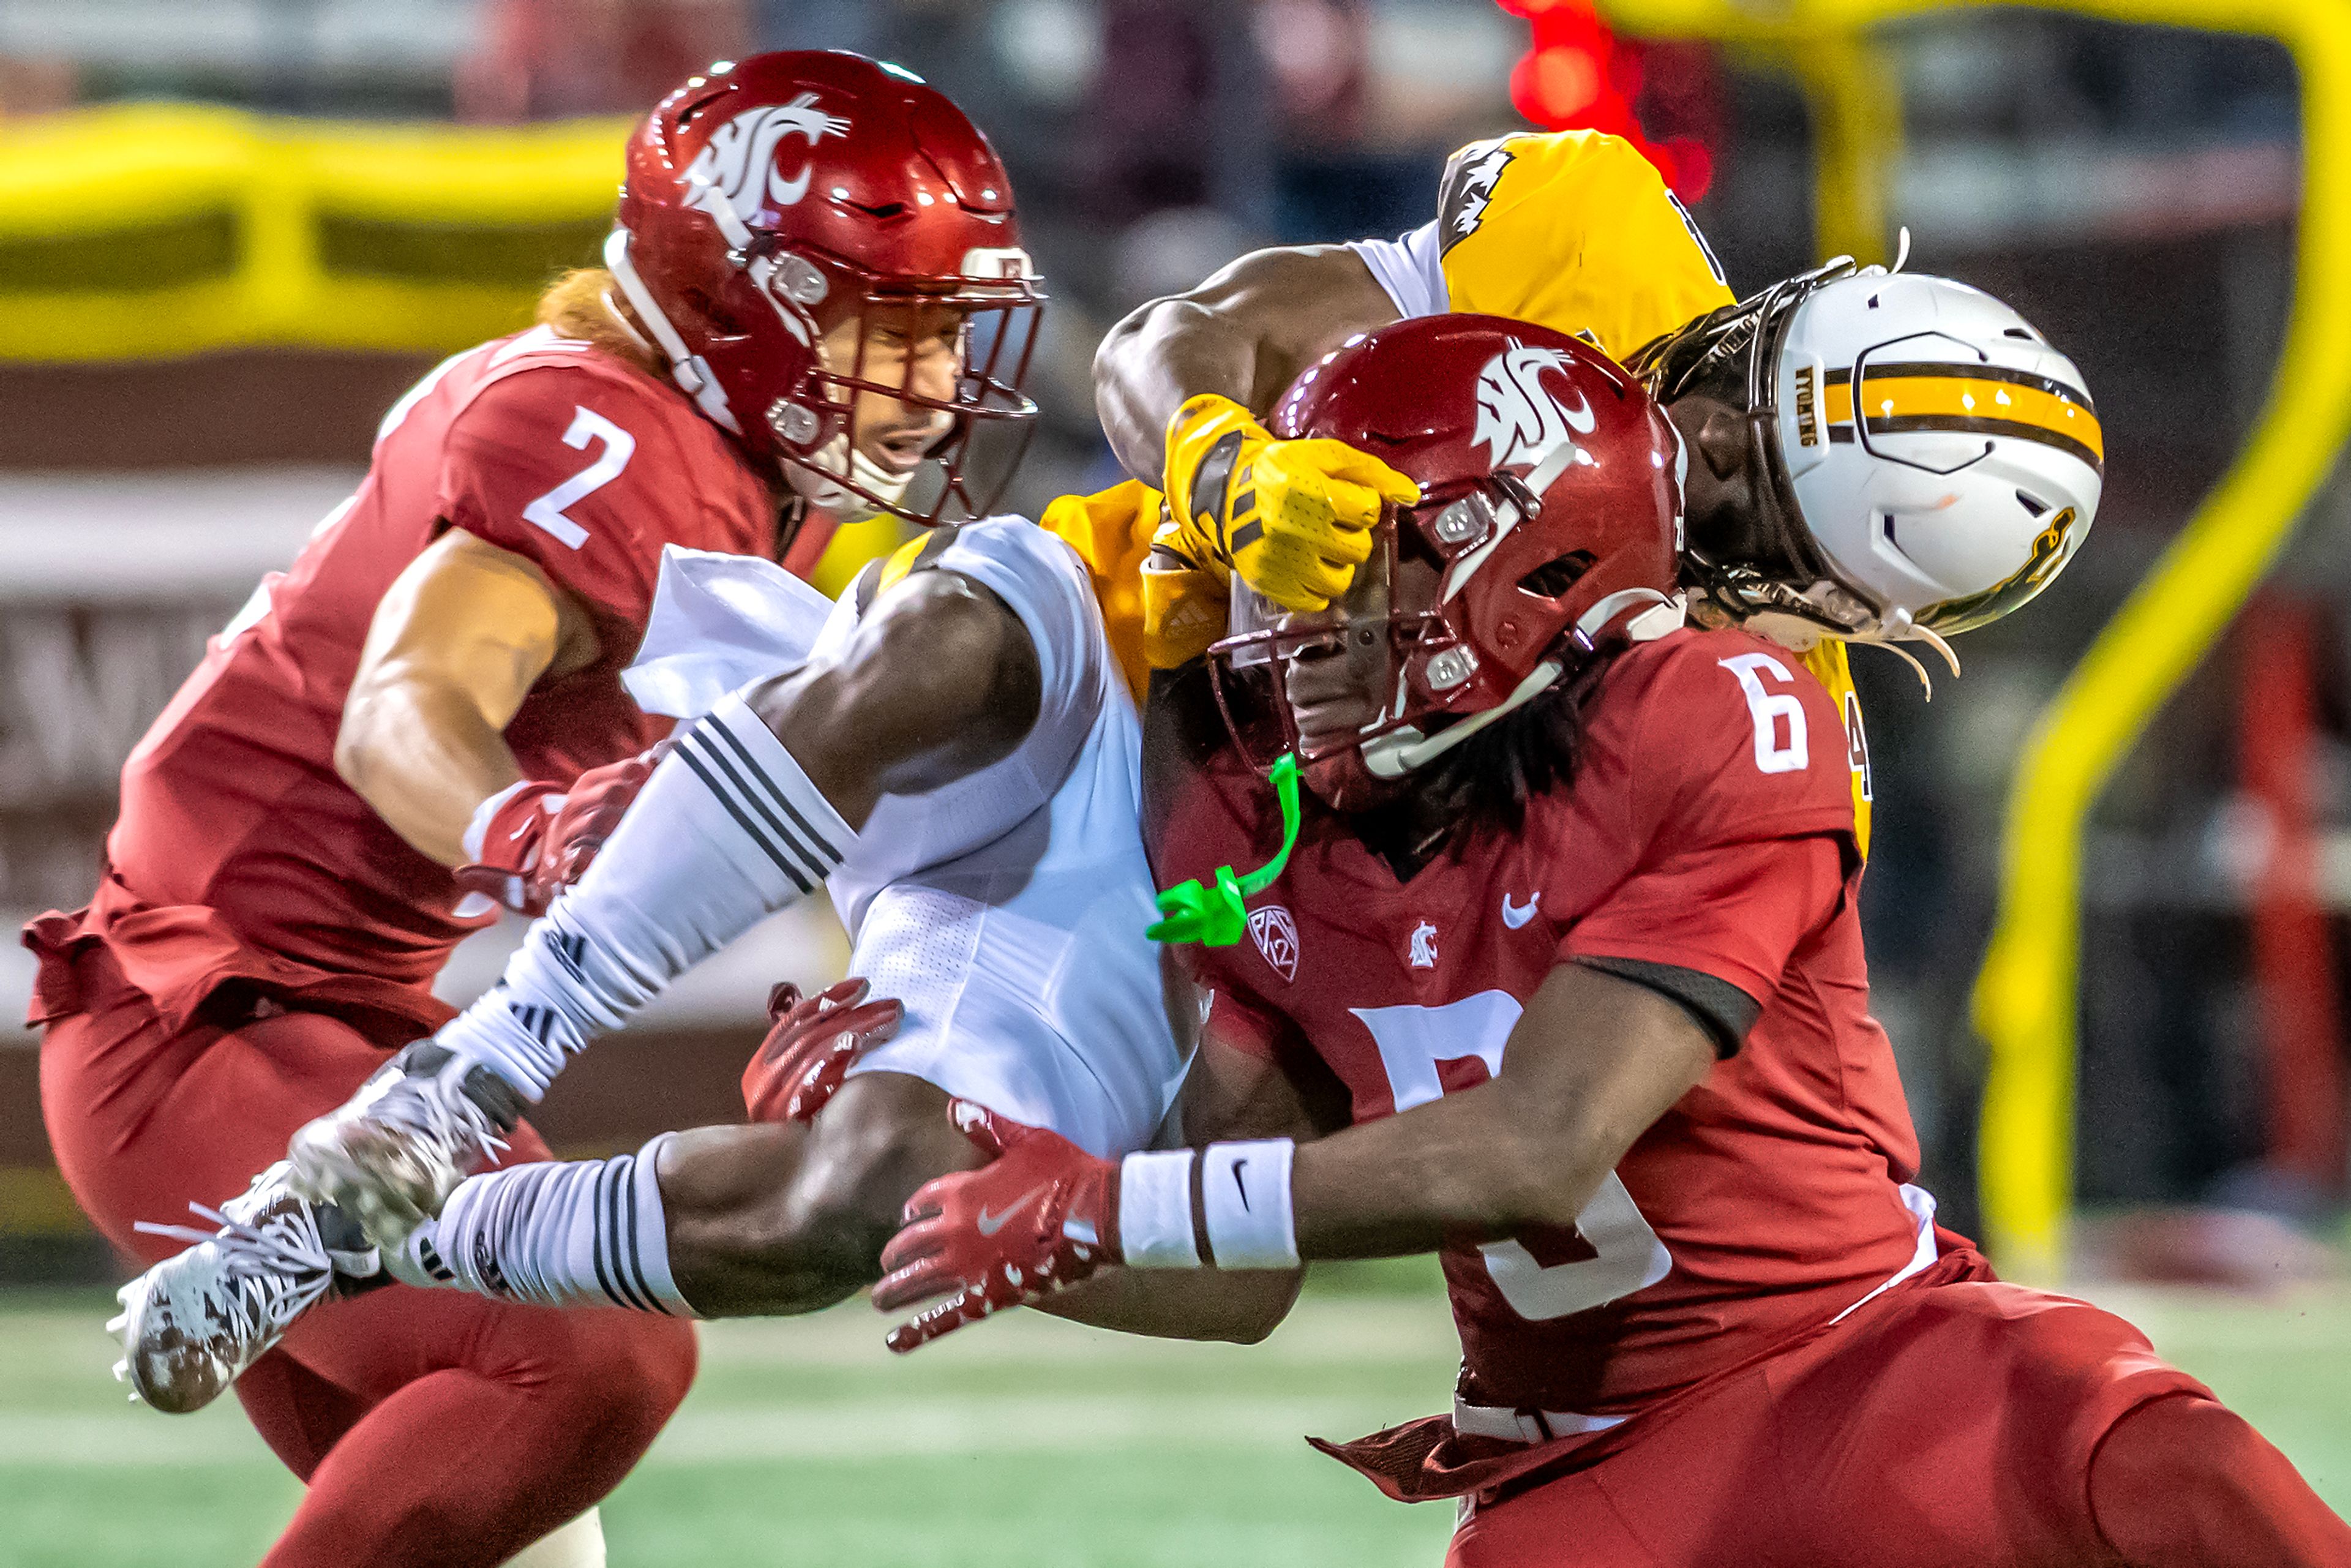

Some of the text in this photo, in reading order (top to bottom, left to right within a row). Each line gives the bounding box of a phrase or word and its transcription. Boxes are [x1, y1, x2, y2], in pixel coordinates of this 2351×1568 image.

[522, 405, 636, 550] 2
[1718, 653, 1809, 774] 6
[1845, 691, 1873, 802] 4
[1250, 910, 1297, 955] PAC
[1269, 938, 1294, 967] 12
